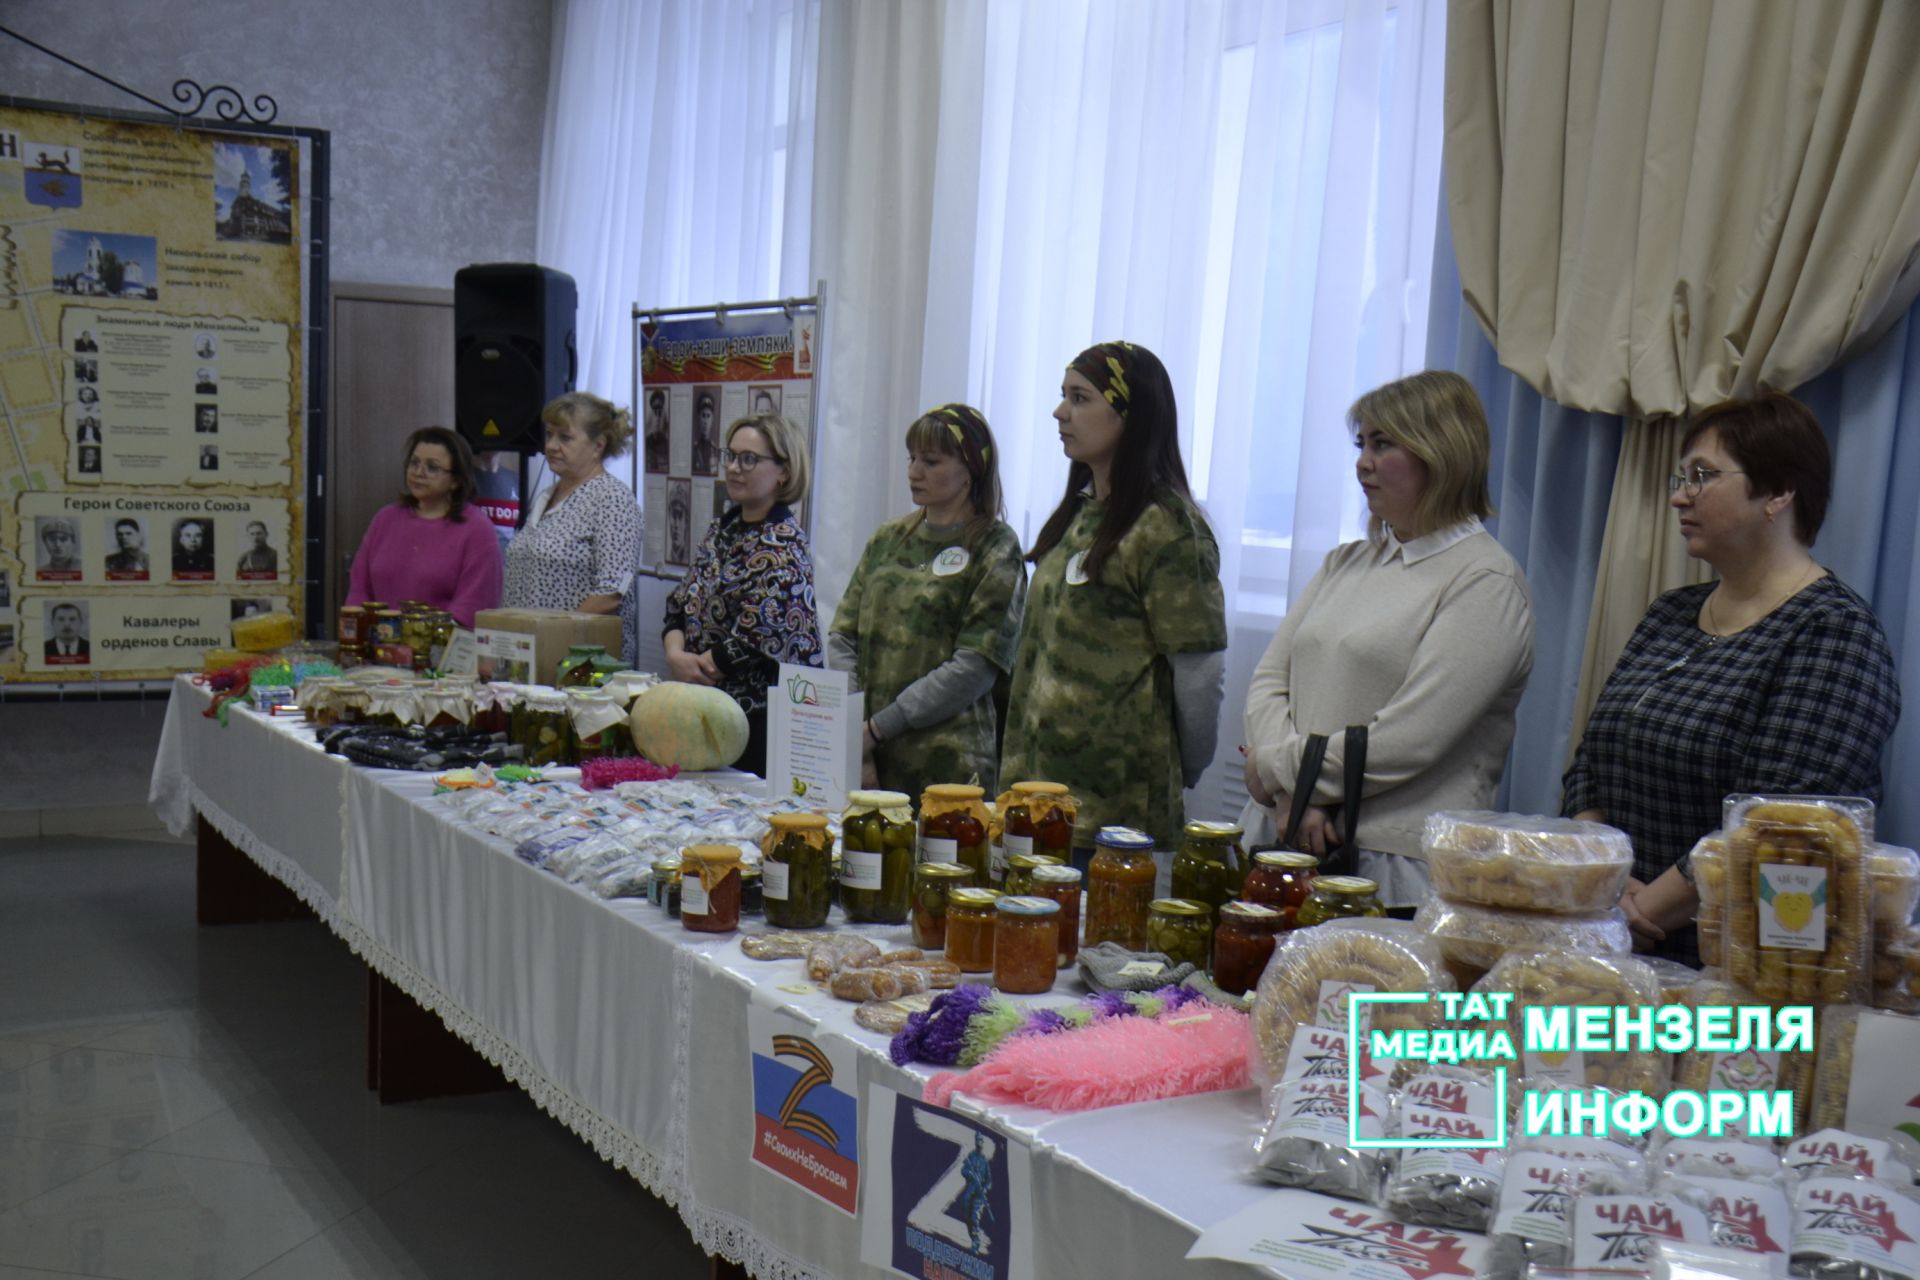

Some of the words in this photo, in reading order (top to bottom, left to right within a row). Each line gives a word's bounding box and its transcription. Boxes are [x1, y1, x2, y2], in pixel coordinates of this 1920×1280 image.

[165, 246, 227, 259] Никольский
[230, 251, 261, 264] собор
[96, 314, 160, 328] Знаменитые
[164, 319, 191, 331] люди
[194, 319, 260, 333] Мензелинска
[64, 497, 111, 511] Герои
[115, 498, 200, 511] Советского
[204, 499, 250, 512] Союза
[123, 616, 200, 631] Кавалеры
[101, 638, 168, 650] орденов
[173, 635, 221, 648] Славы
[1407, 1080, 1464, 1103] ЧАЙ
[1410, 1114, 1476, 1137] ЧАЙ
[764, 1130, 848, 1190] #СвоихНеБросаем
[1799, 1142, 1869, 1165] ЧАЙ
[1708, 1195, 1759, 1219] АЙ
[1809, 1189, 1887, 1215] ЧАЙ
[1595, 1200, 1674, 1230] ЧАЙ
[1329, 1207, 1461, 1250] ЧАЙ
